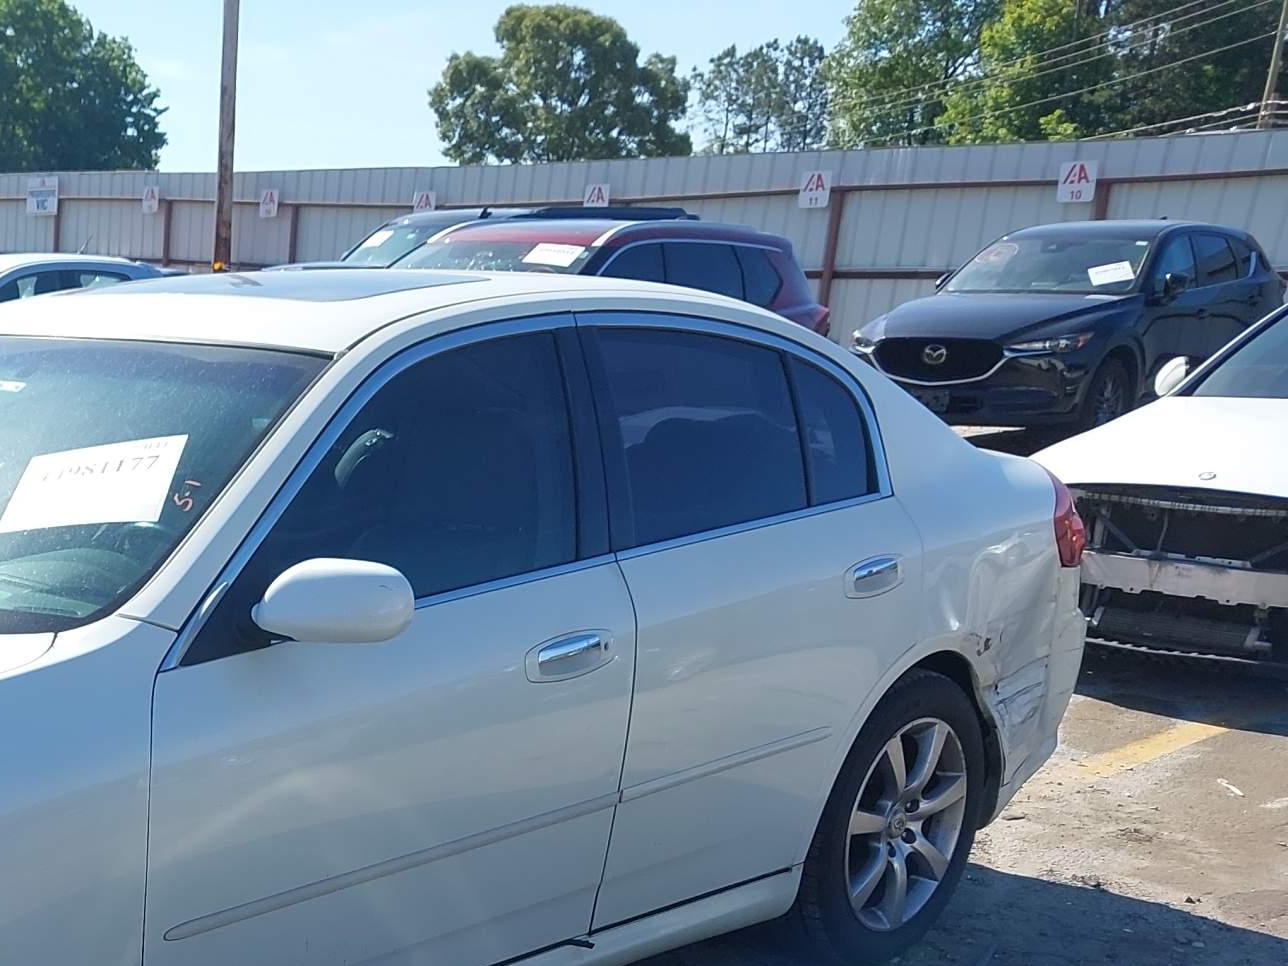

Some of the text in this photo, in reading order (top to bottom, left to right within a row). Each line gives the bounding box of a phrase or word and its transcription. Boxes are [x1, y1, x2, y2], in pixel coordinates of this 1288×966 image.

[1070, 190, 1082, 201] 10
[808, 196, 819, 207] 11
[40, 454, 161, 482] 981177
